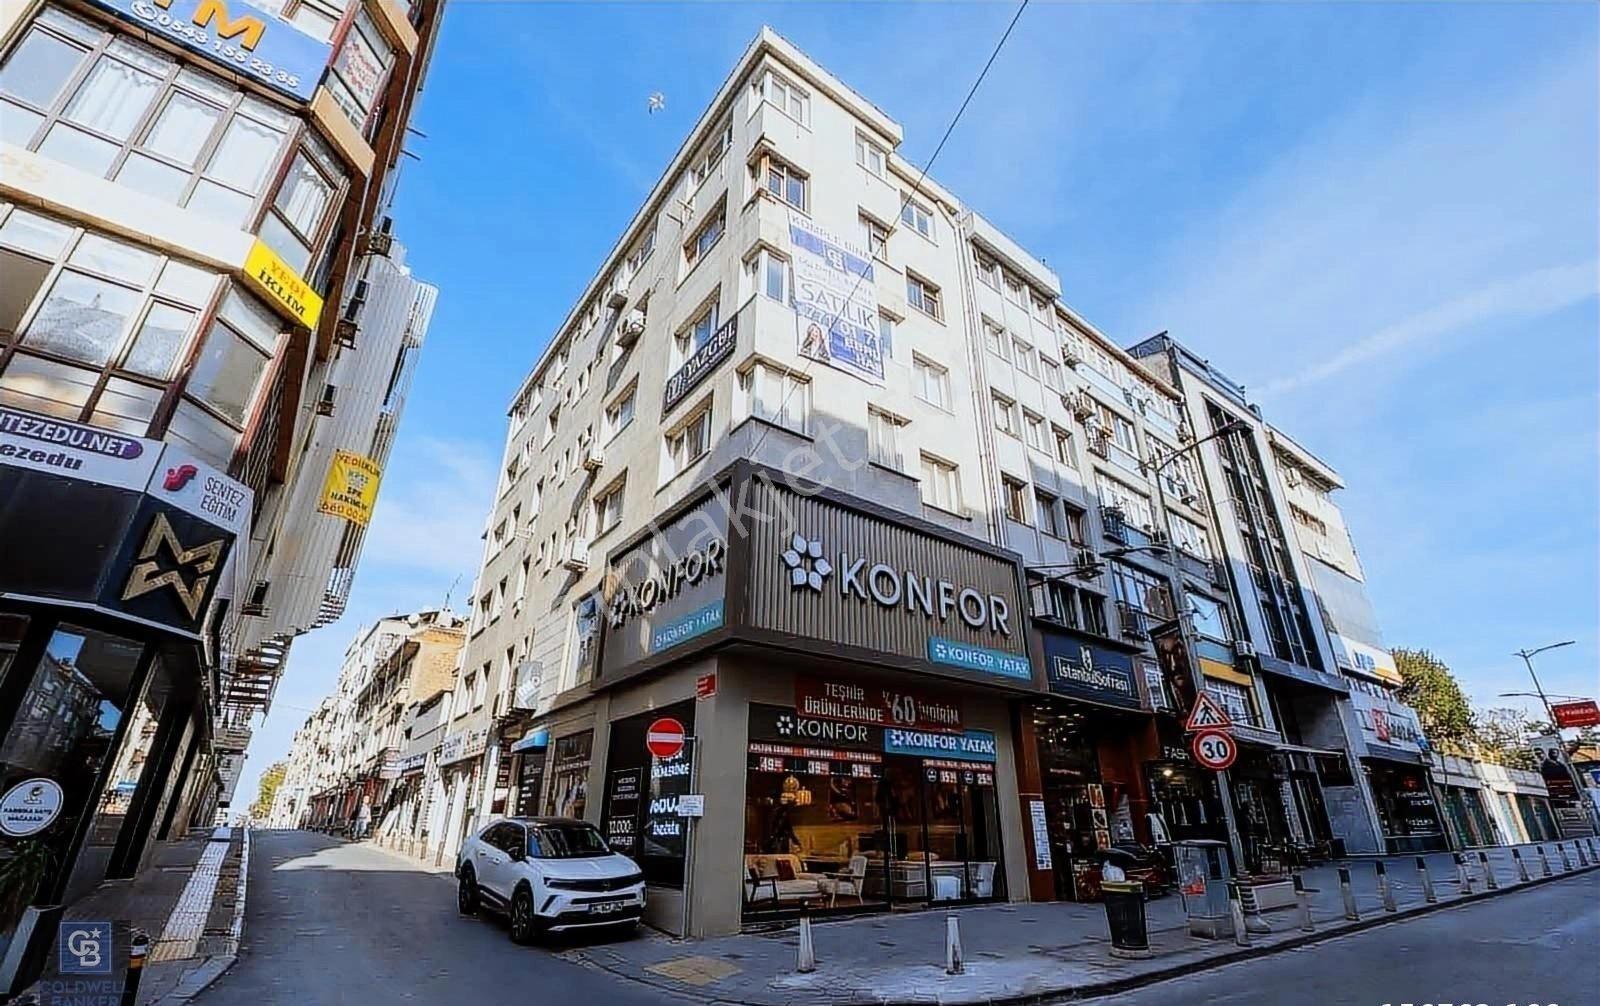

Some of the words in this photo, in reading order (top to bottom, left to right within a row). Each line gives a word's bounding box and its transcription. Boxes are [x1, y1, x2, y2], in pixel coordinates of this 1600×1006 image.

[158, 14, 209, 45] 0543
[213, 37, 248, 63] 155
[250, 58, 274, 77] 23
[276, 70, 301, 89] 35
[801, 283, 876, 332] SATILIK
[204, 476, 246, 508] SENTEZ
[627, 538, 721, 616] KONFOR
[839, 551, 1012, 637] KONFOR
[949, 646, 995, 669] KONFOR
[804, 696, 884, 722] ÜRÜNLERİNDE
[796, 718, 869, 743] KONFOR
[904, 729, 957, 751] KONFOR
[960, 736, 996, 754] YATAK
[1202, 741, 1229, 759] 30
